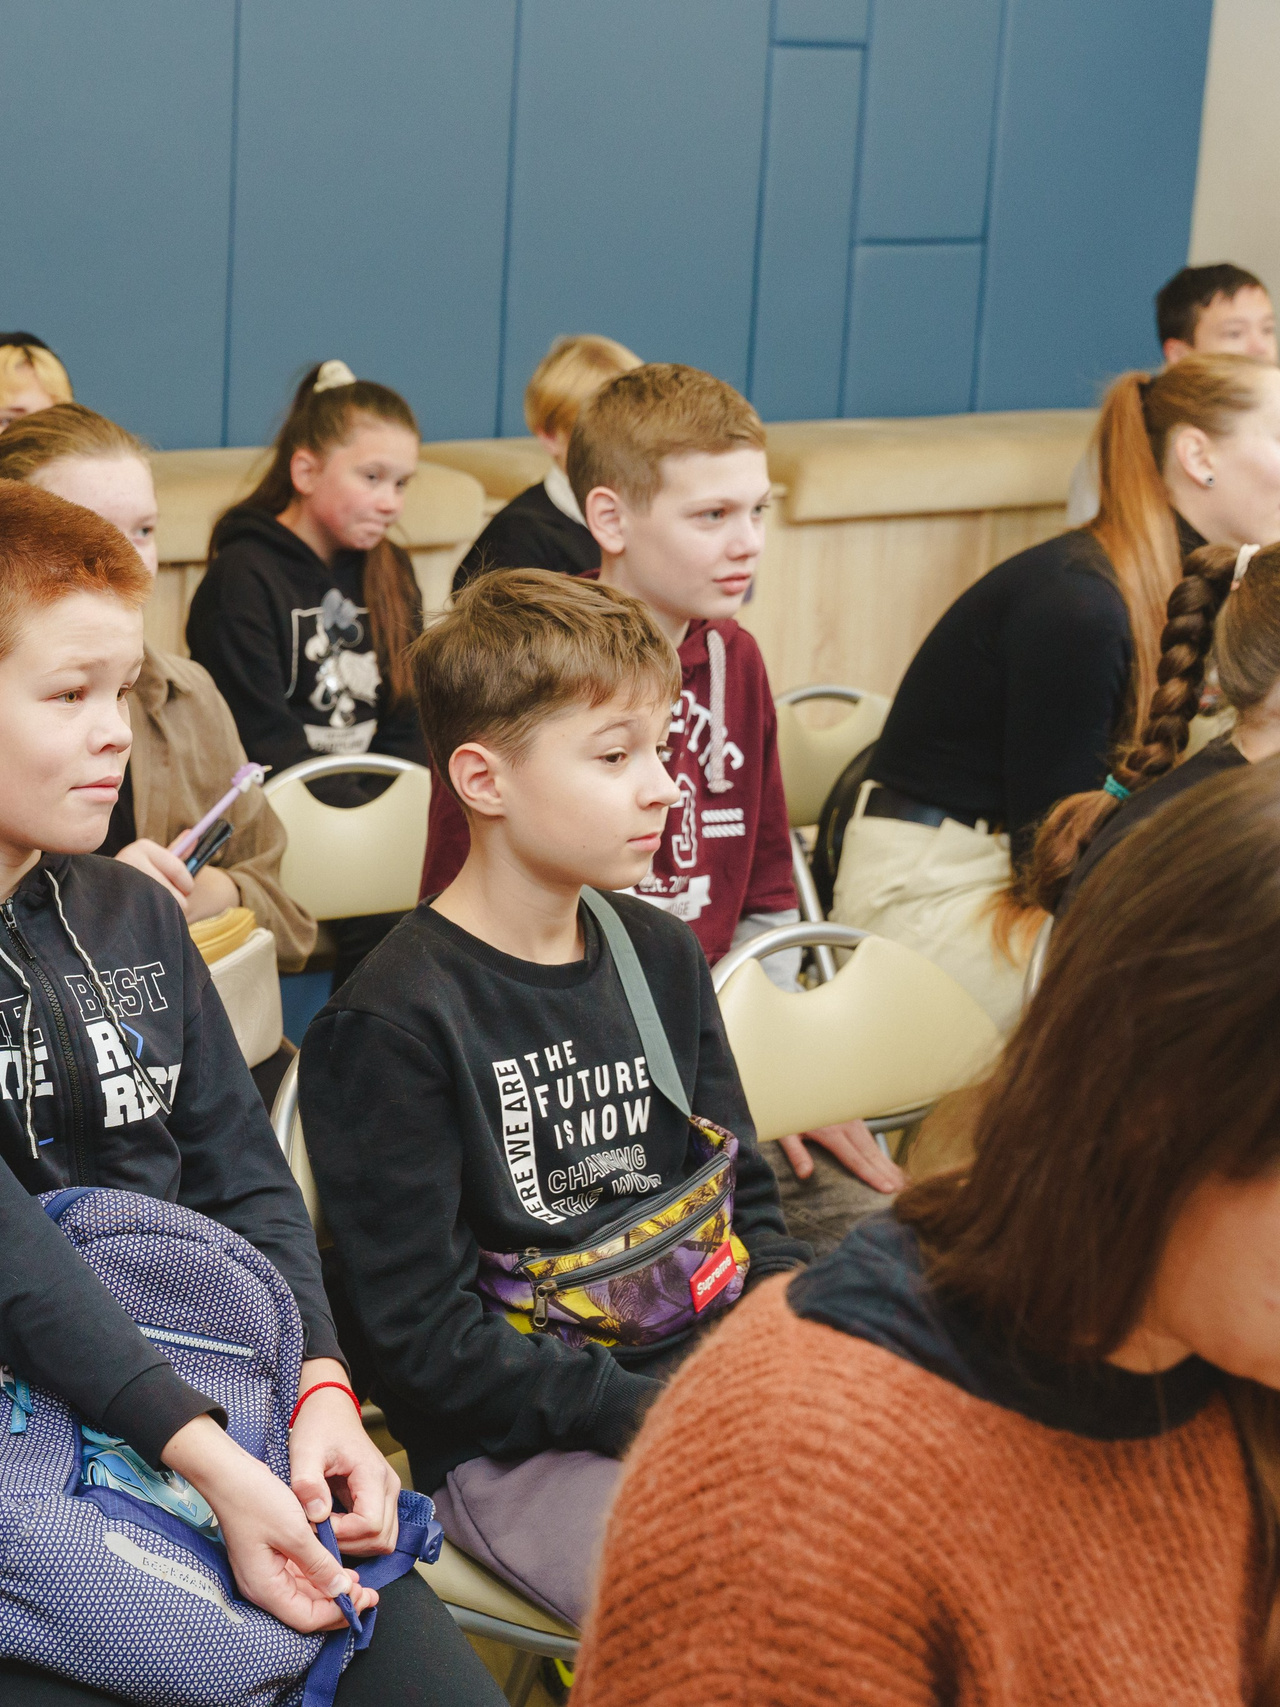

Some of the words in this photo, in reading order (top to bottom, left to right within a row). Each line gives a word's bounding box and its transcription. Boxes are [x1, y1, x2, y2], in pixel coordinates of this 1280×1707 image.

[64, 961, 168, 1022] BEST
[524, 1040, 577, 1077] THE
[497, 1063, 528, 1113] ARE
[534, 1056, 651, 1118] FUTURE
[506, 1121, 532, 1165] WE
[554, 1119, 575, 1150] IS
[580, 1096, 652, 1147] NOW
[514, 1168, 558, 1222] HERE
[551, 1187, 604, 1217] THE
[696, 1255, 732, 1297] Supreme
